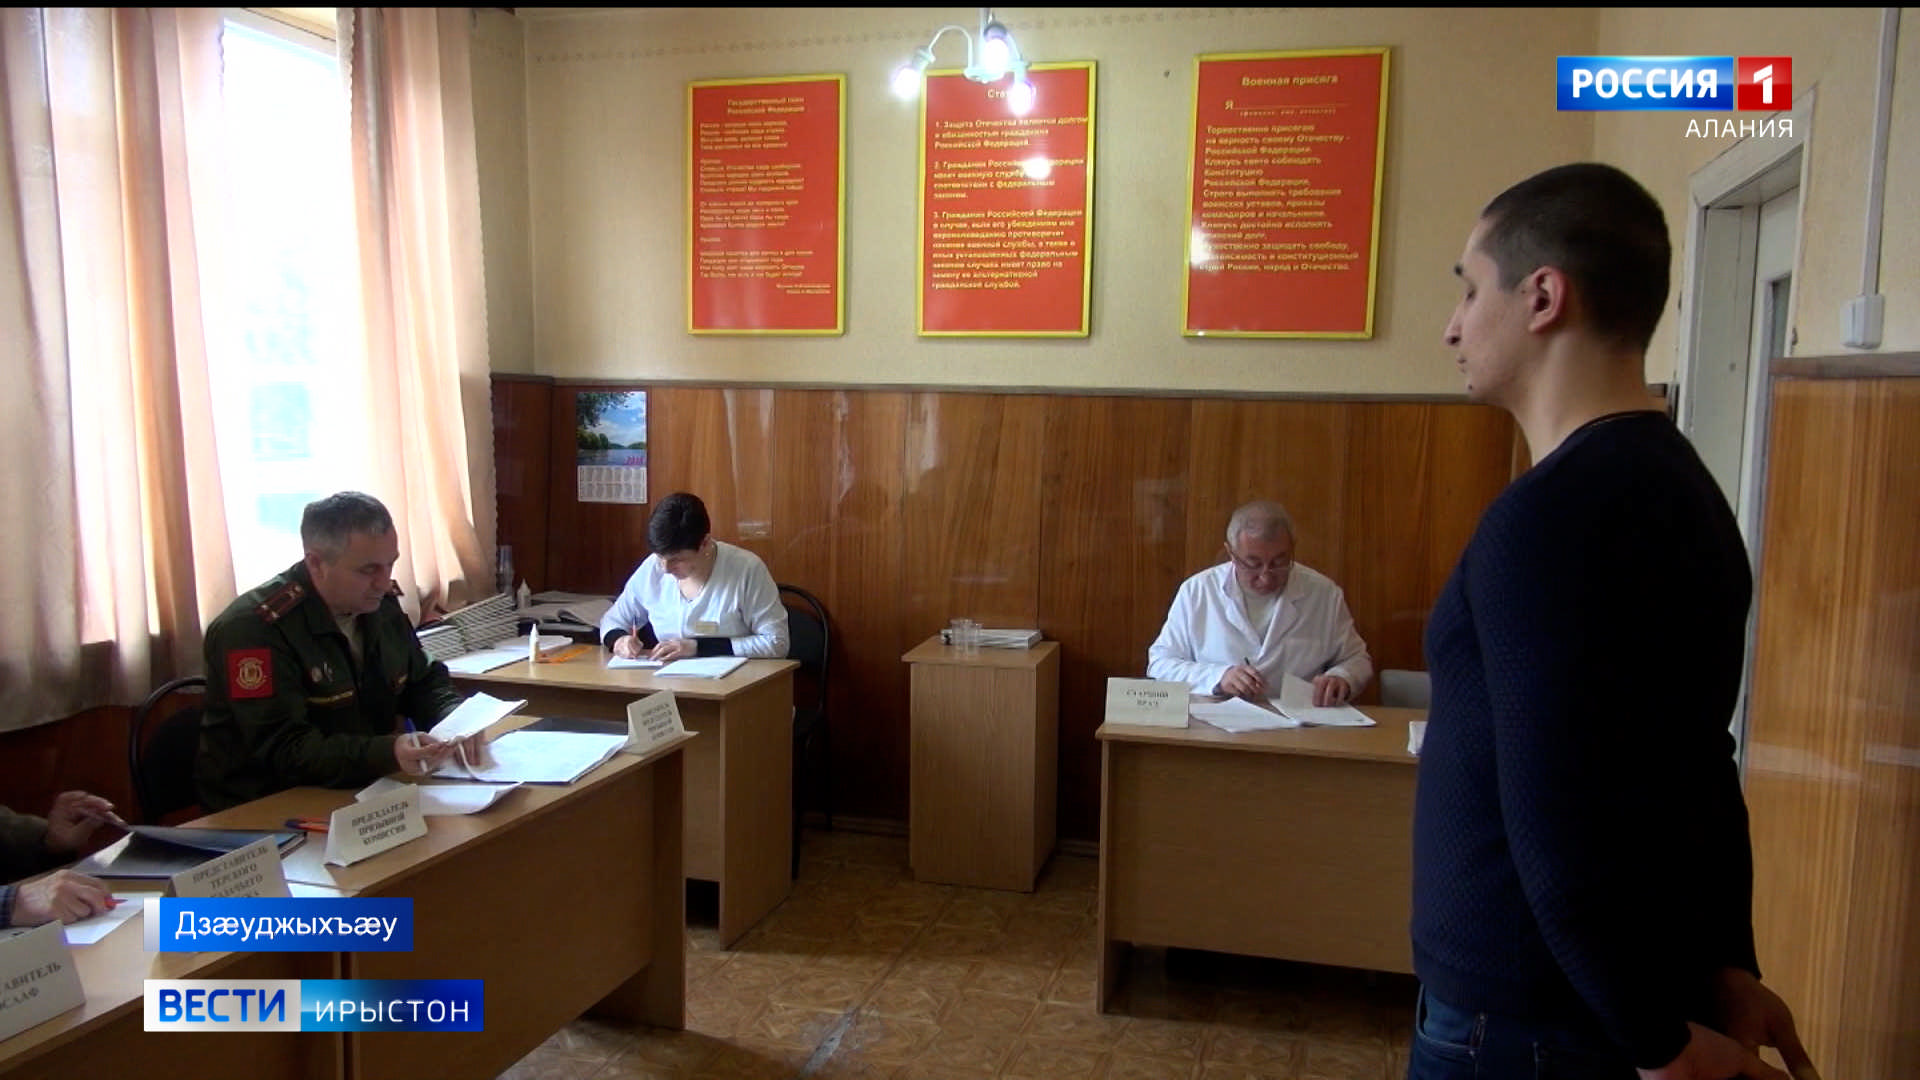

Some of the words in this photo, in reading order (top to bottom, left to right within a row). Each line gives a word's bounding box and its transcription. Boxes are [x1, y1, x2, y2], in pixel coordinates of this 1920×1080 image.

[1242, 77, 1290, 86] Военная
[1293, 75, 1338, 86] присяга
[1225, 100, 1234, 110] Я
